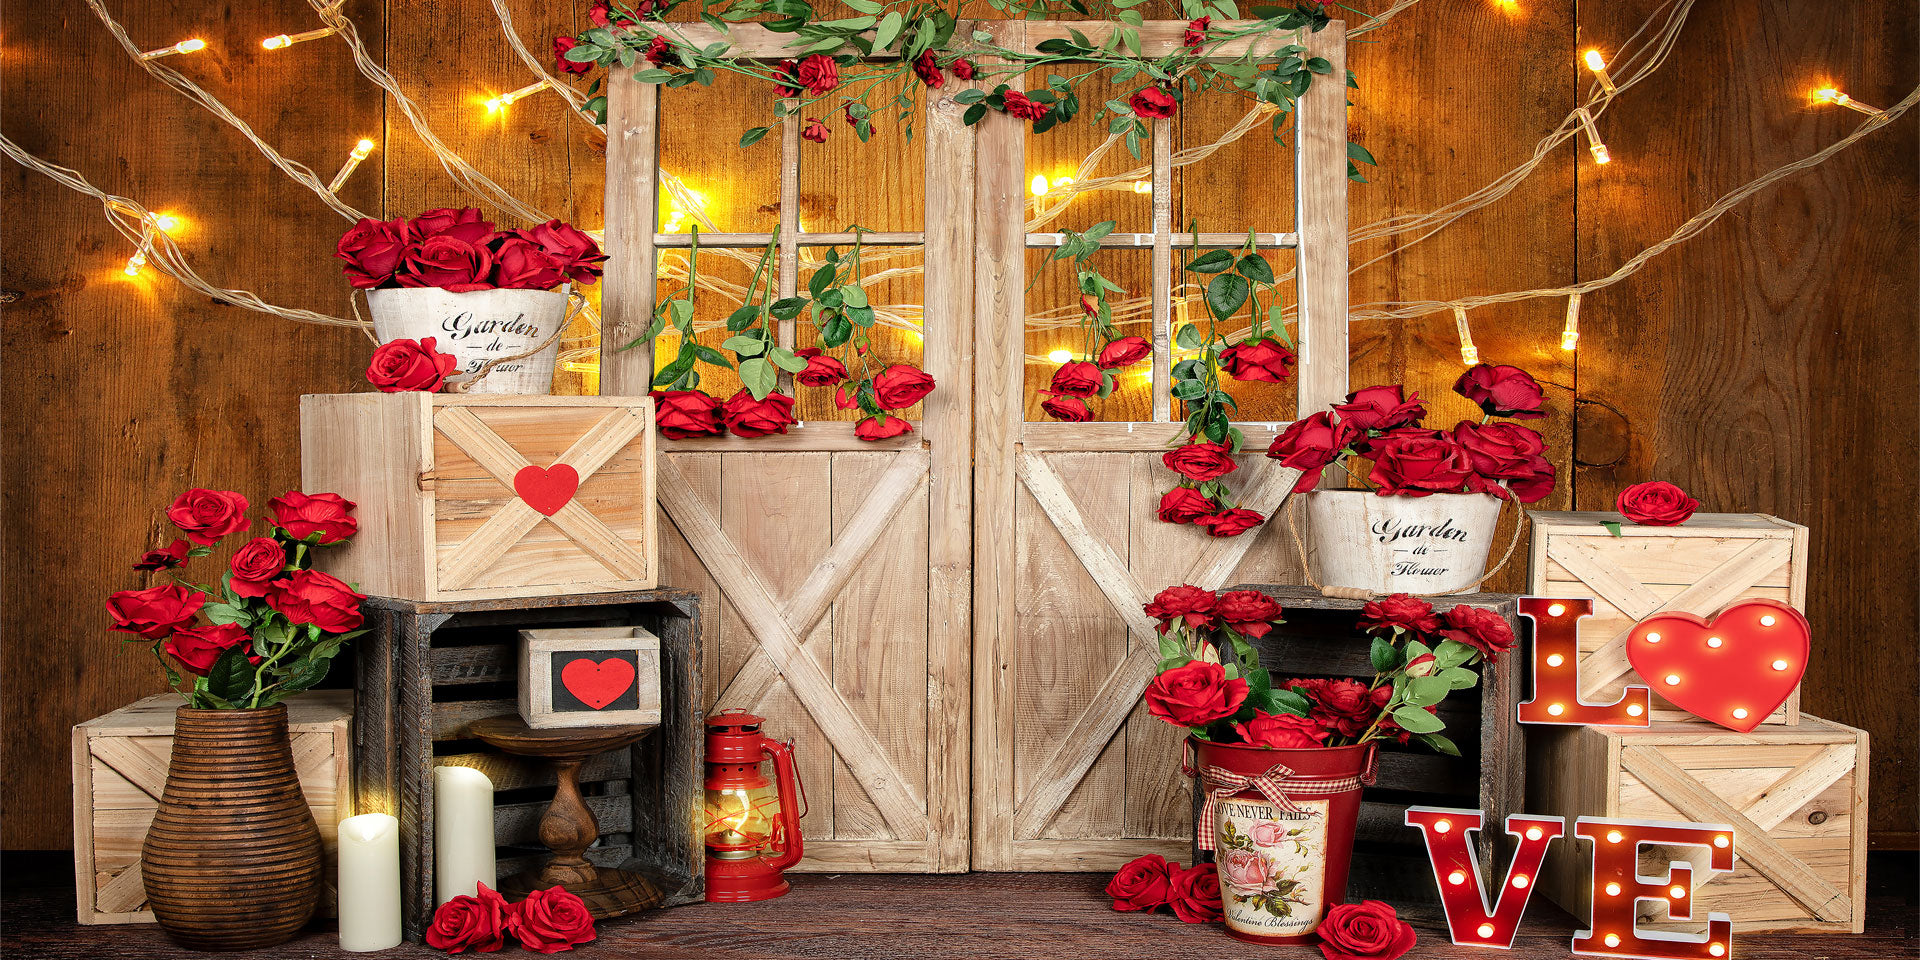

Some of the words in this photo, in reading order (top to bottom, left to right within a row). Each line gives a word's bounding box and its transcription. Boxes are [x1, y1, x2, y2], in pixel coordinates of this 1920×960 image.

[441, 311, 539, 340] Garden
[486, 336, 504, 351] de
[1372, 518, 1468, 543] Garden
[1412, 541, 1428, 555] de
[1391, 561, 1449, 576] Flower
[1236, 804, 1273, 820] NEVER
[1226, 907, 1263, 927] Valentine
[1264, 915, 1313, 935] Blessings
